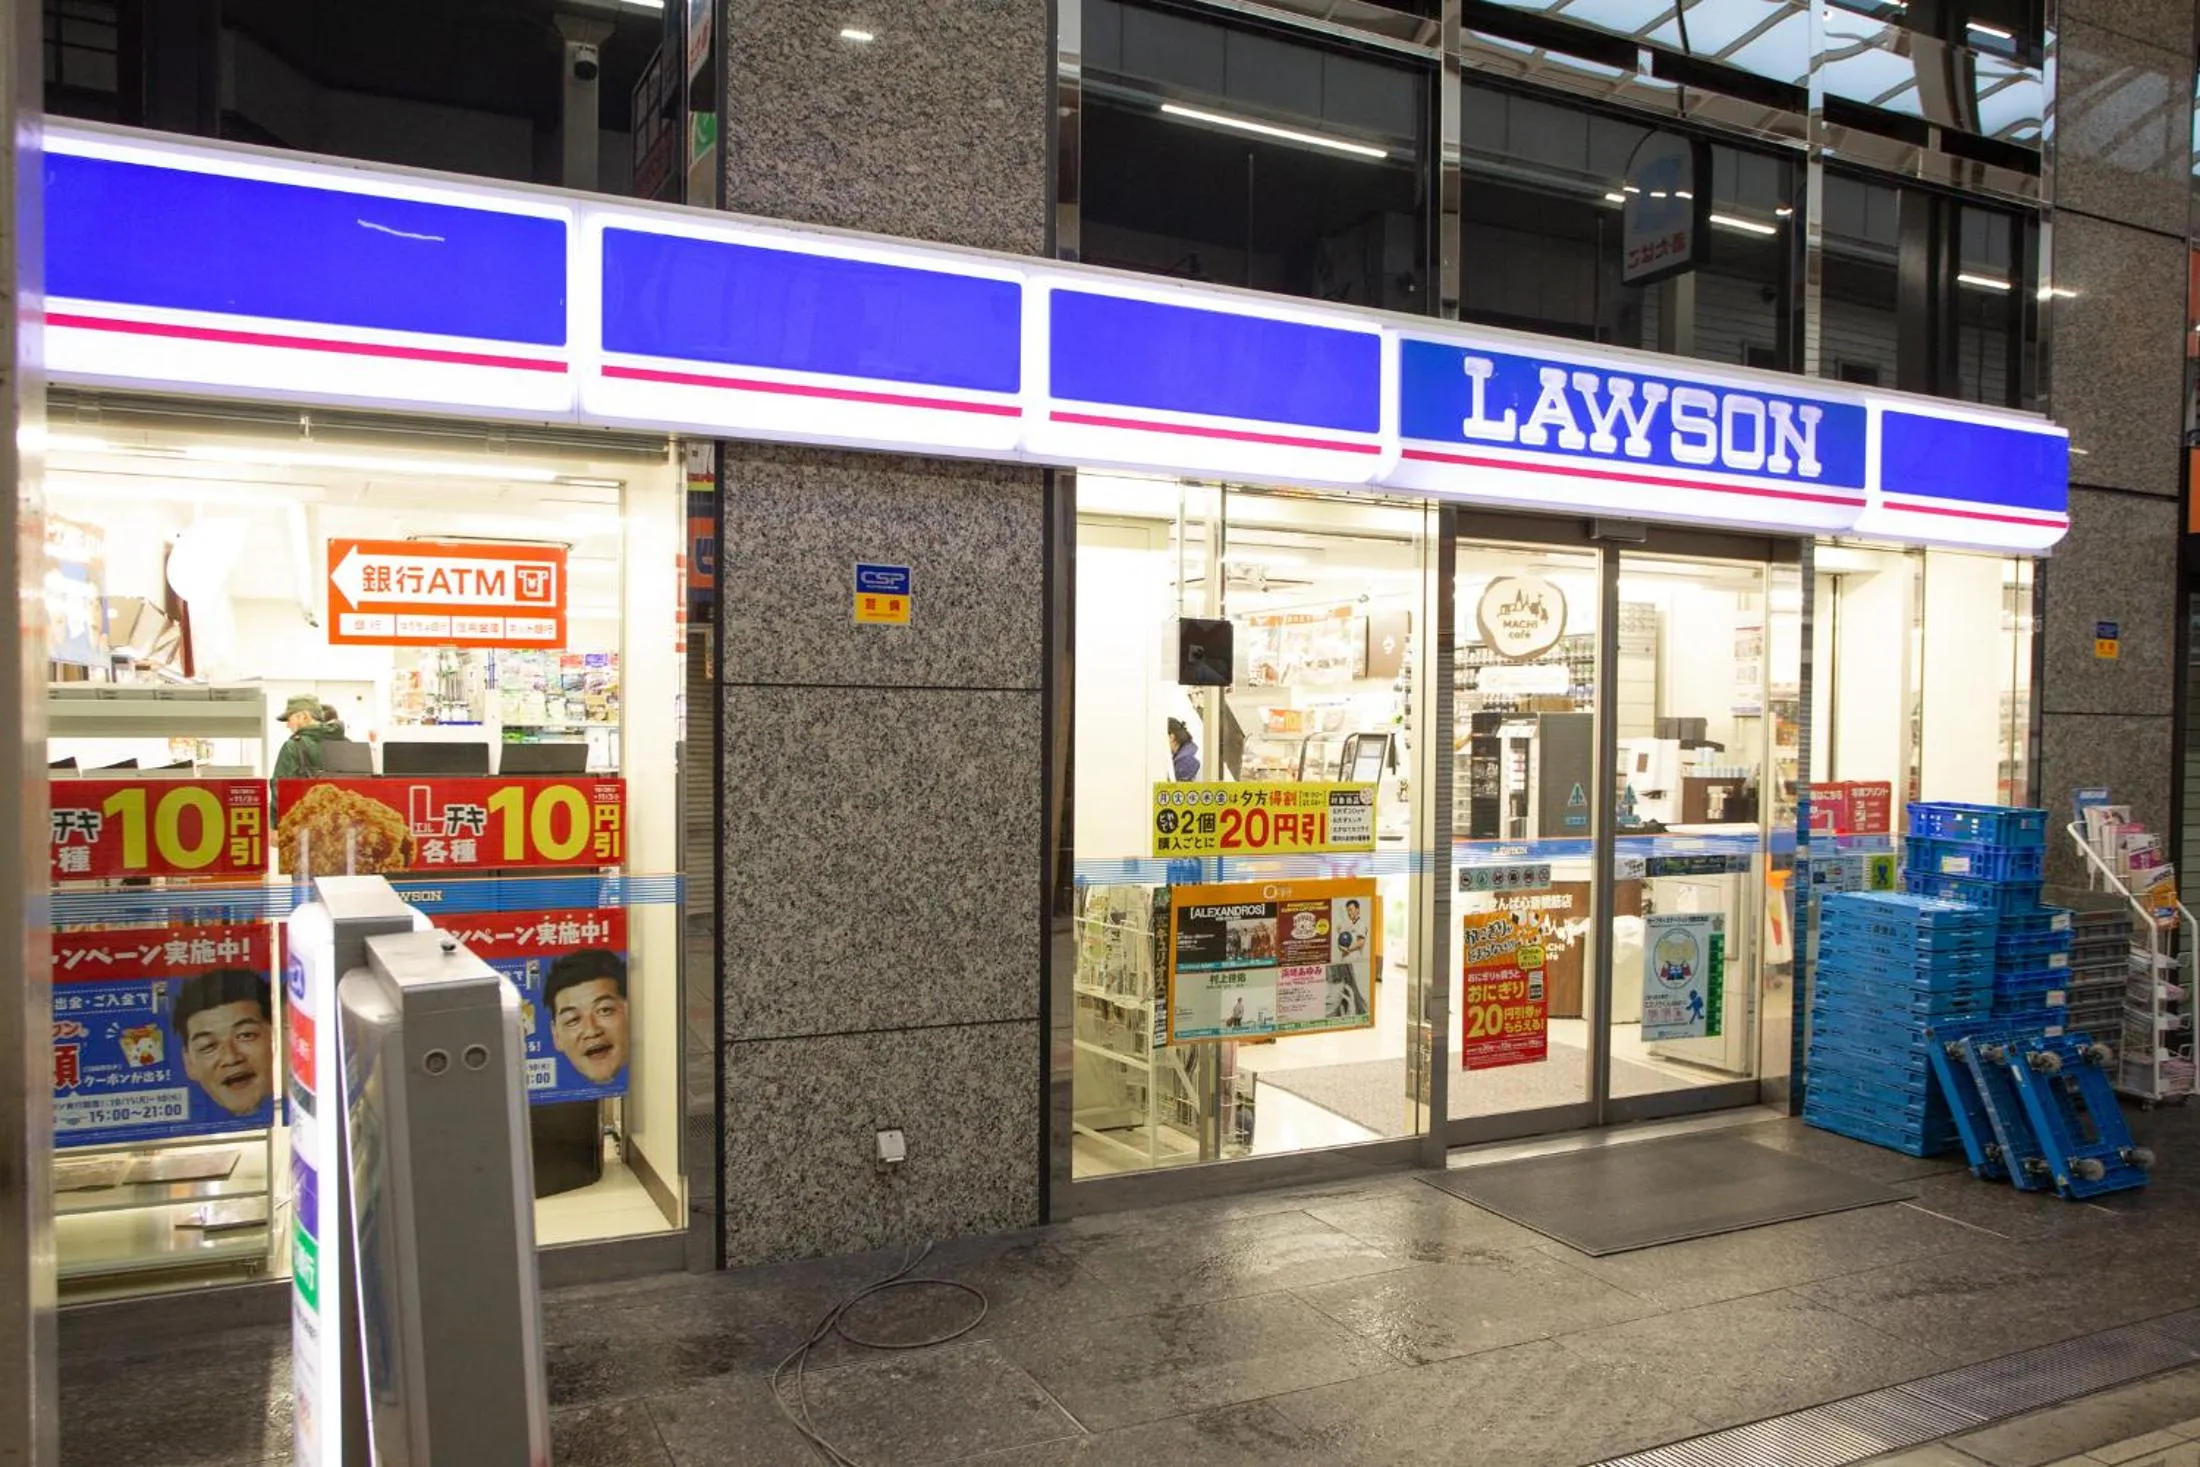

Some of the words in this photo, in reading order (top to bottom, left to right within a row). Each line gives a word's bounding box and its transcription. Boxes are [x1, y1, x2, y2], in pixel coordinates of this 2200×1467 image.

[1463, 356, 1823, 478] LAWSON
[362, 564, 505, 597] 銀行ATM
[1503, 619, 1538, 629] MACHI
[1508, 631, 1531, 639] café
[103, 786, 225, 869] 10
[230, 807, 261, 866] 円引
[487, 784, 591, 861] 10
[595, 804, 620, 858] 円引
[1181, 812, 1216, 834] 2個
[1220, 807, 1326, 848] 20円引
[52, 846, 91, 872] 種
[422, 839, 478, 863] 各種
[1468, 980, 1525, 1004] おにぎり
[1467, 1003, 1504, 1039] 20
